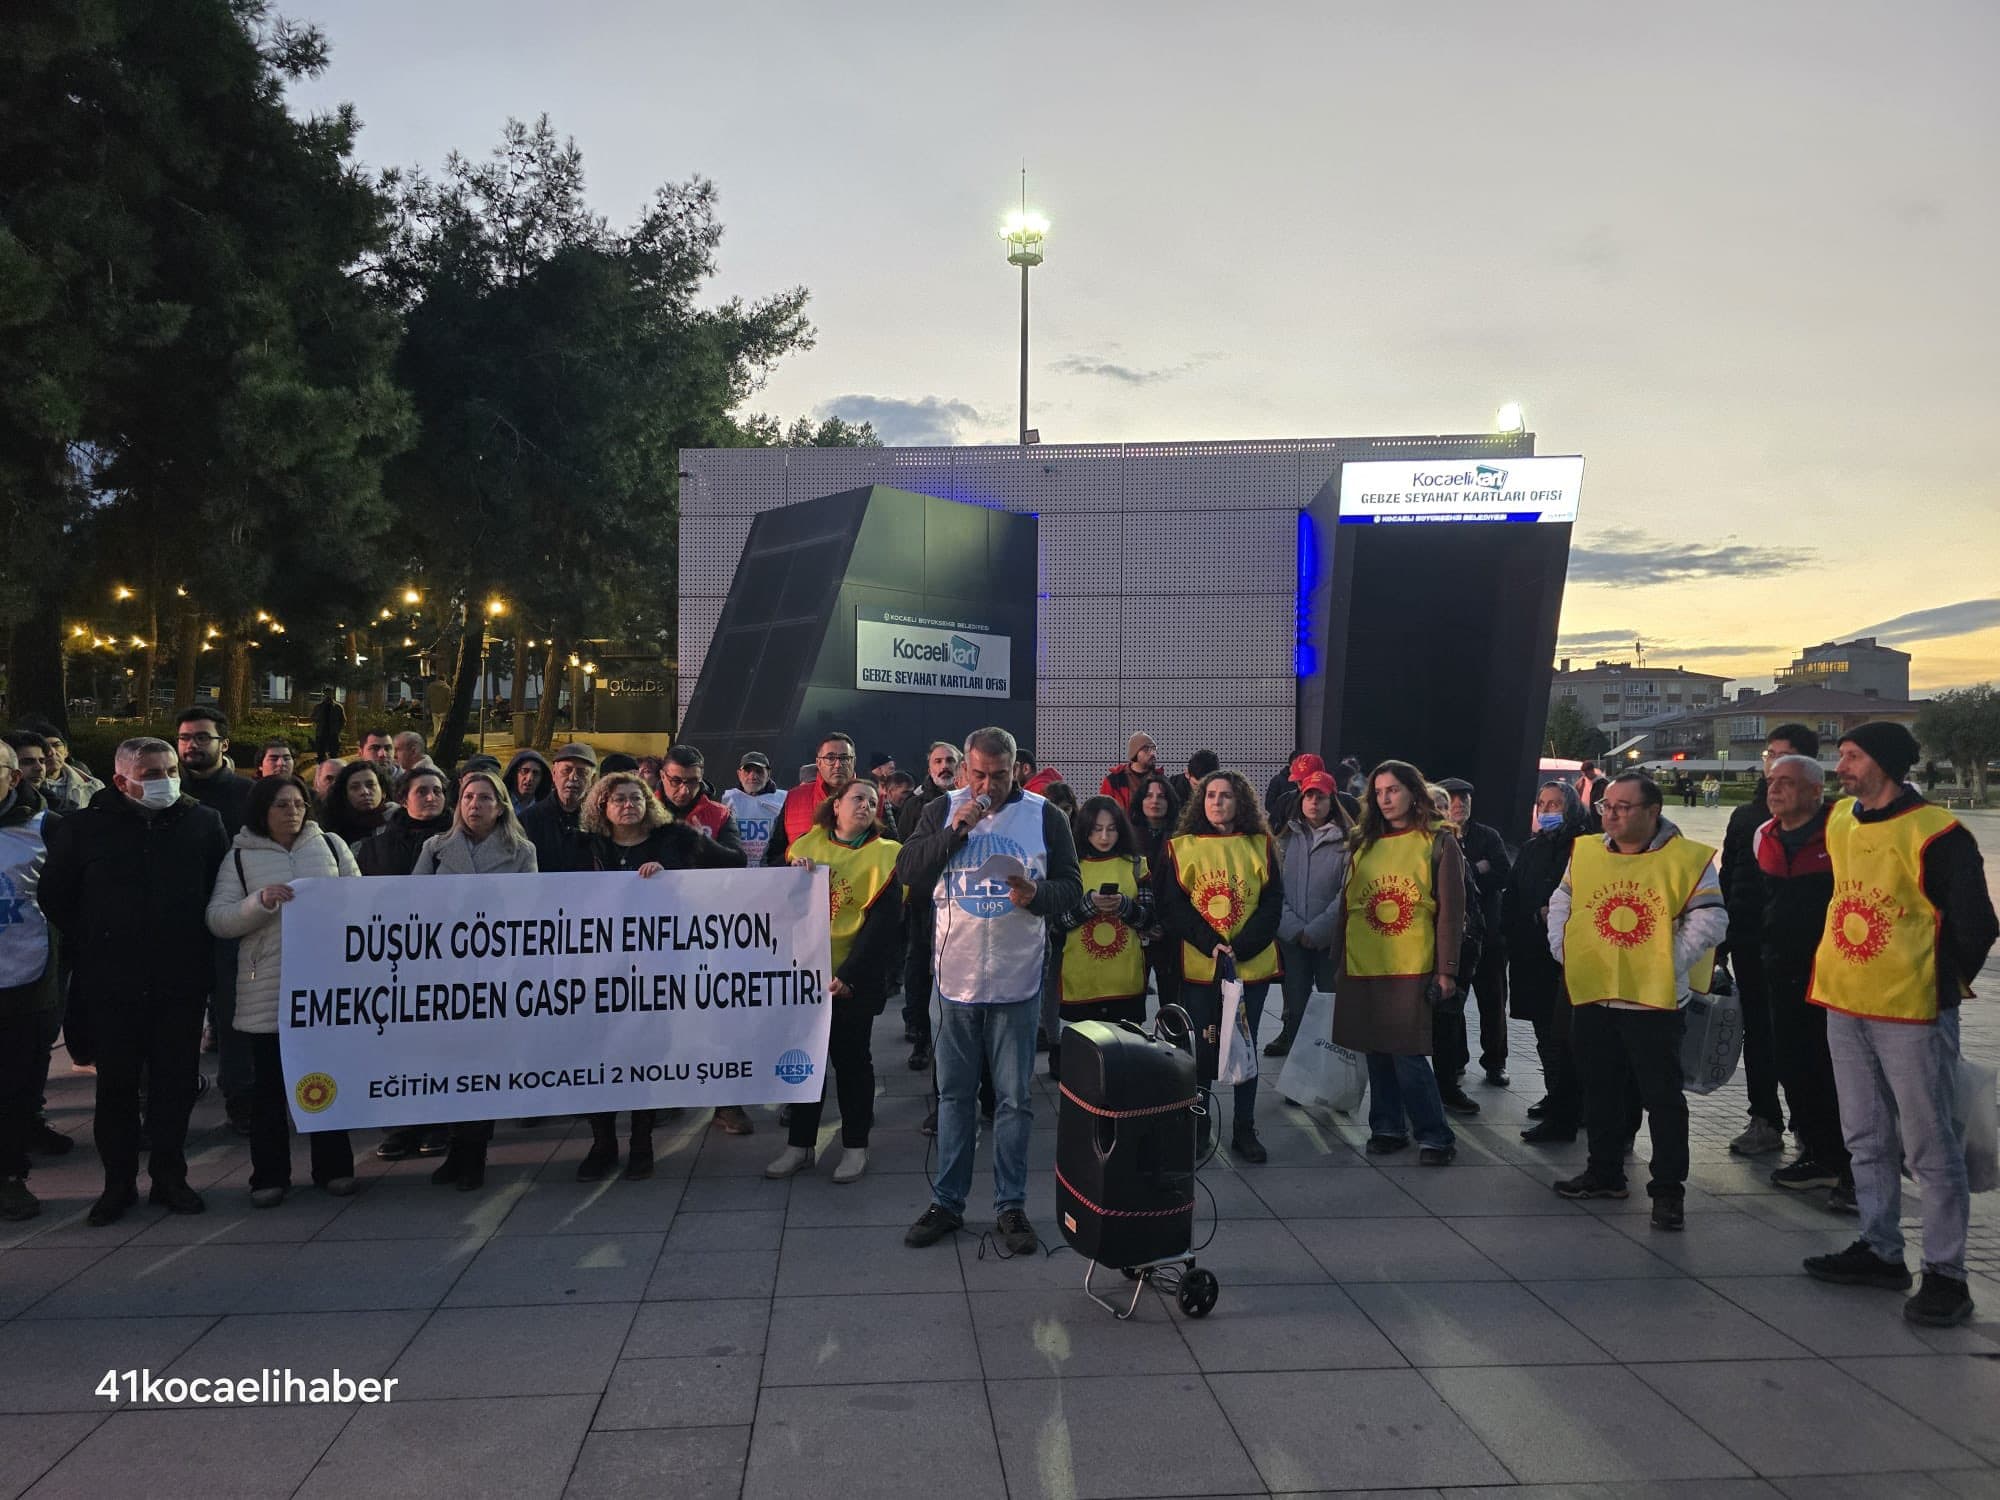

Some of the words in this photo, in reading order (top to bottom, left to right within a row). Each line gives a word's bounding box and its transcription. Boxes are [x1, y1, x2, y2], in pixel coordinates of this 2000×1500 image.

[1361, 493, 1400, 504] GEBZE
[1405, 491, 1459, 503] SEYAHAT
[1463, 490, 1526, 502] KARTLARI
[862, 668, 892, 684] GEBZE
[895, 672, 938, 687] SEYAHAT
[940, 675, 983, 690] KARTLARI
[975, 901, 1004, 913] 1995
[345, 913, 443, 972] DÜŞÜK
[450, 907, 613, 960] GÖSTERİLEN
[622, 912, 778, 956] ENFLASYON,
[290, 974, 507, 1037] EMEKÇİLERDEN
[515, 978, 586, 1018] GASP
[595, 965, 687, 1015] EDİLEN
[695, 959, 822, 1011] ÜCRETTİR!
[369, 1072, 449, 1099] EĞİTİM
[456, 1073, 501, 1093] SEN
[508, 1062, 605, 1091] KOCAELİ
[611, 1066, 624, 1084] 2
[630, 1063, 690, 1083] NOLU
[696, 1061, 753, 1085] ŞUBE
[775, 1063, 815, 1076] KESK
